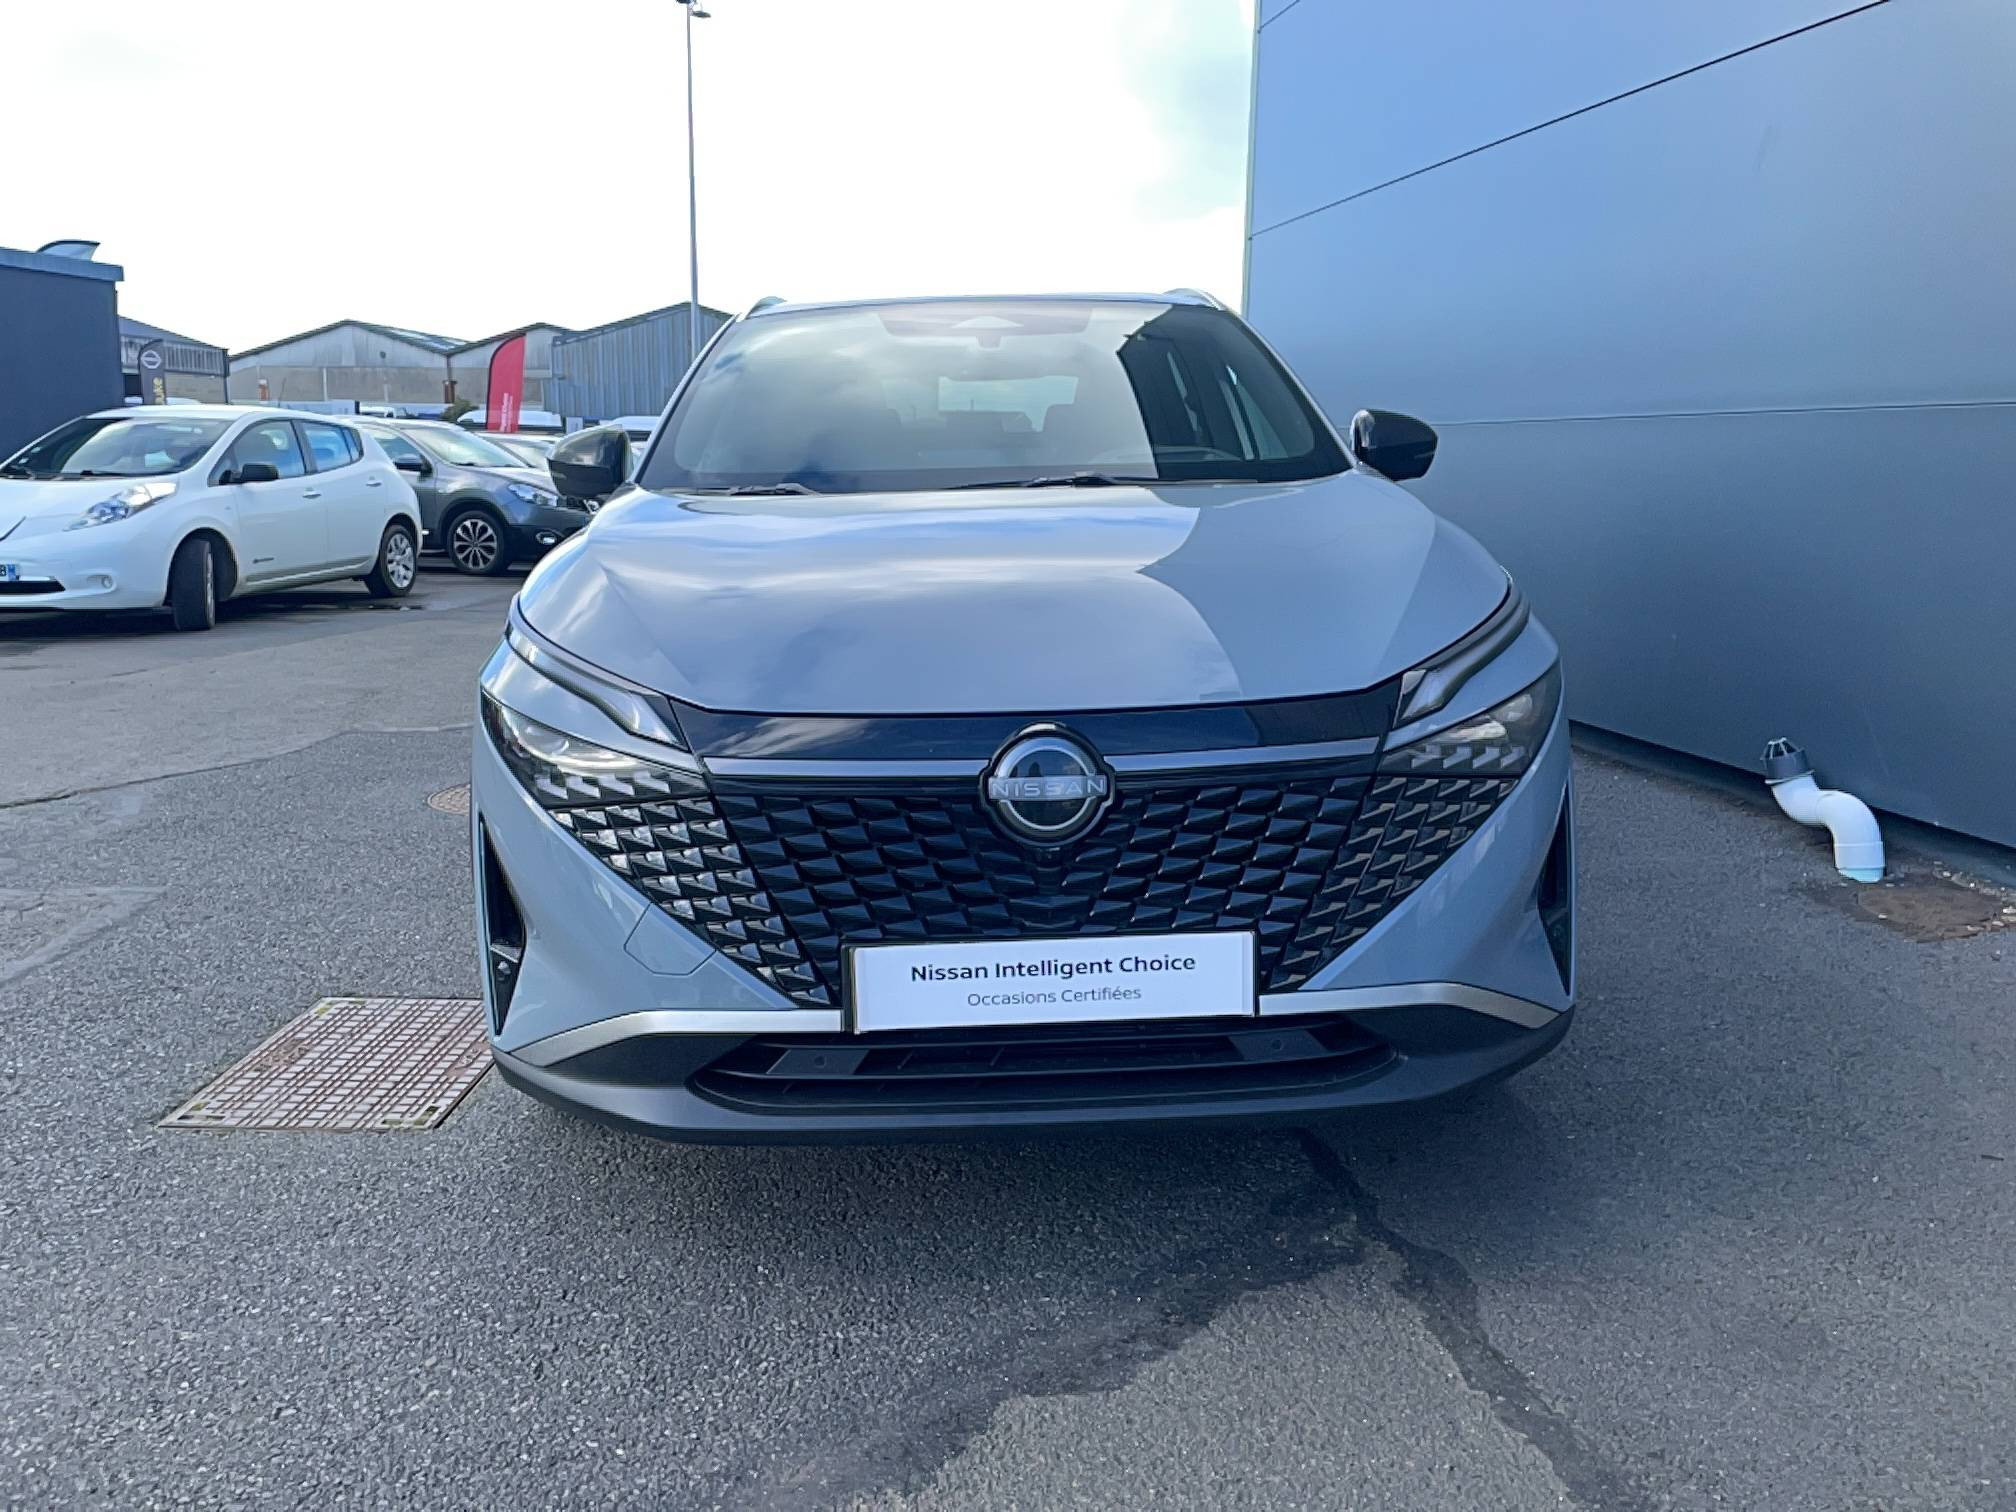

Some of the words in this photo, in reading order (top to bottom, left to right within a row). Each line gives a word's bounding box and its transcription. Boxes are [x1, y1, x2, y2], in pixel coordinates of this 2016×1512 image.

[992, 779, 1104, 797] NISSAN
[911, 963, 988, 982] Nissan
[995, 958, 1113, 980] Intelligent
[1118, 954, 1196, 973] Choice
[967, 990, 1057, 1007] Occasions
[1060, 985, 1142, 1003] Certifiées
